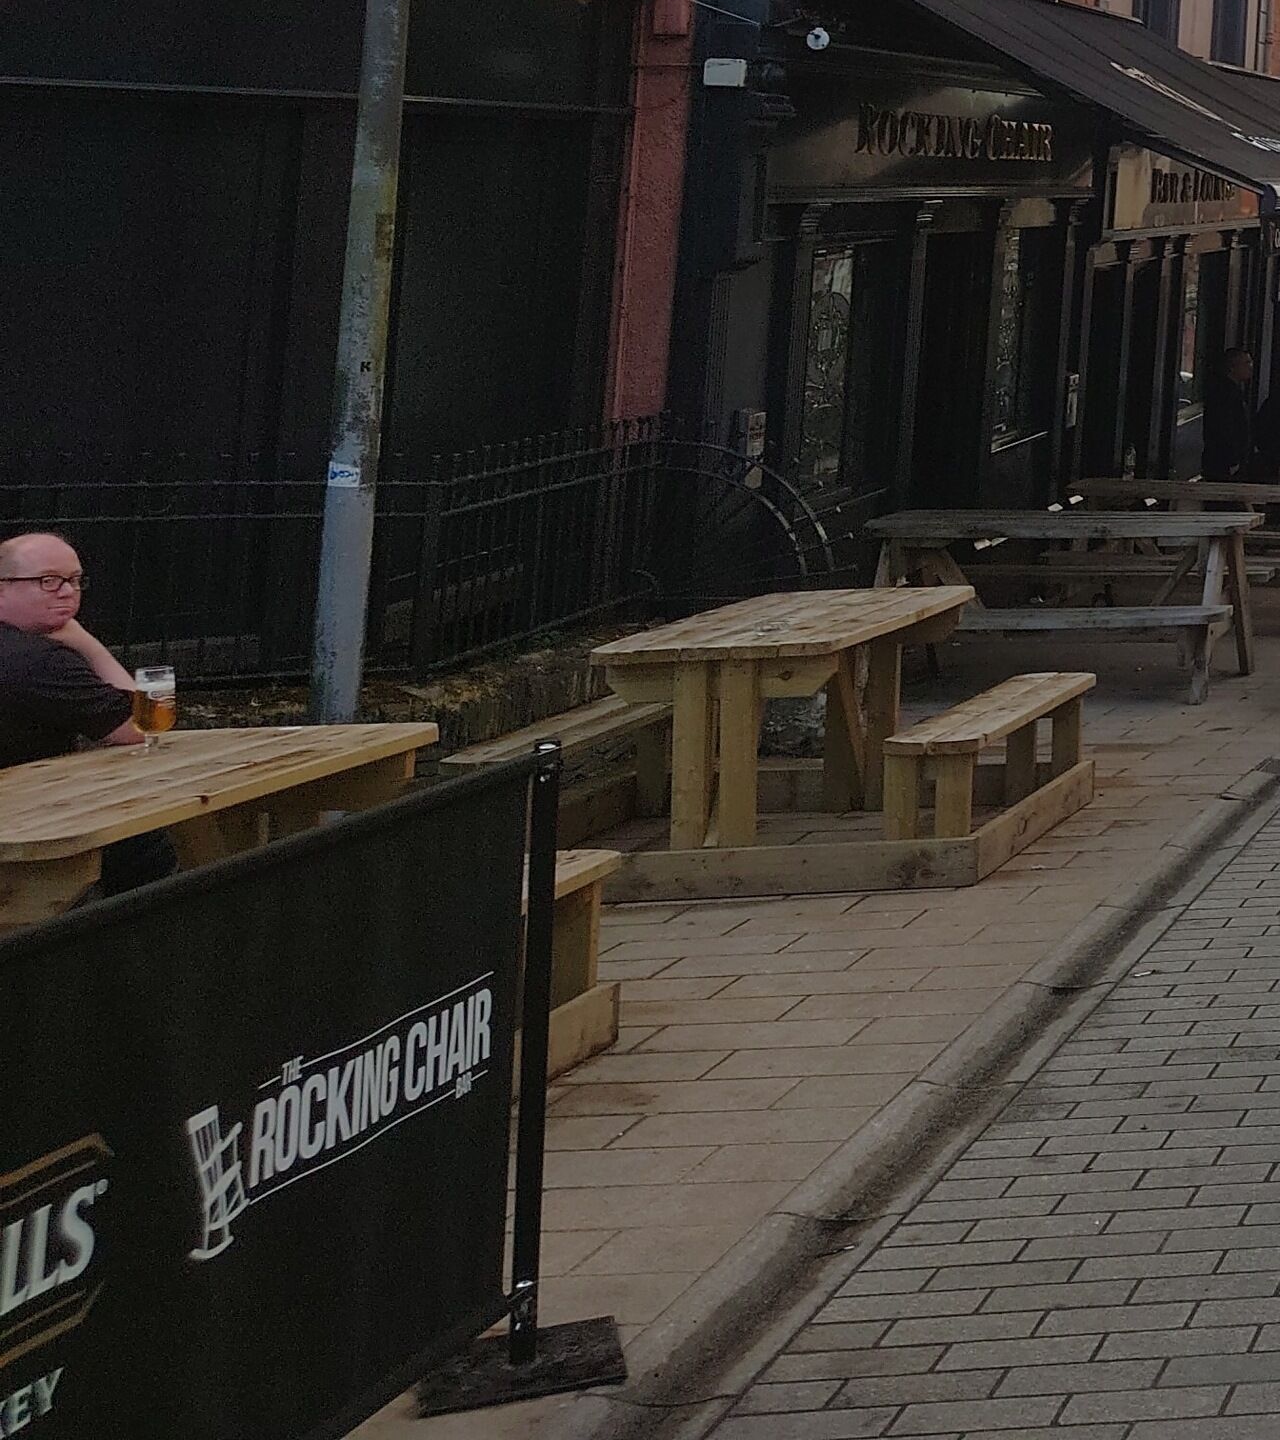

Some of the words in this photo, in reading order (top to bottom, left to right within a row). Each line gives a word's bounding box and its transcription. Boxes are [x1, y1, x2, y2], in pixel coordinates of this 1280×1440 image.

[855, 103, 983, 160] ROCKING
[249, 1034, 400, 1189] ROCKING
[404, 988, 493, 1102] CHAIR
[281, 1055, 304, 1086] THE
[456, 1071, 473, 1099] BAR
